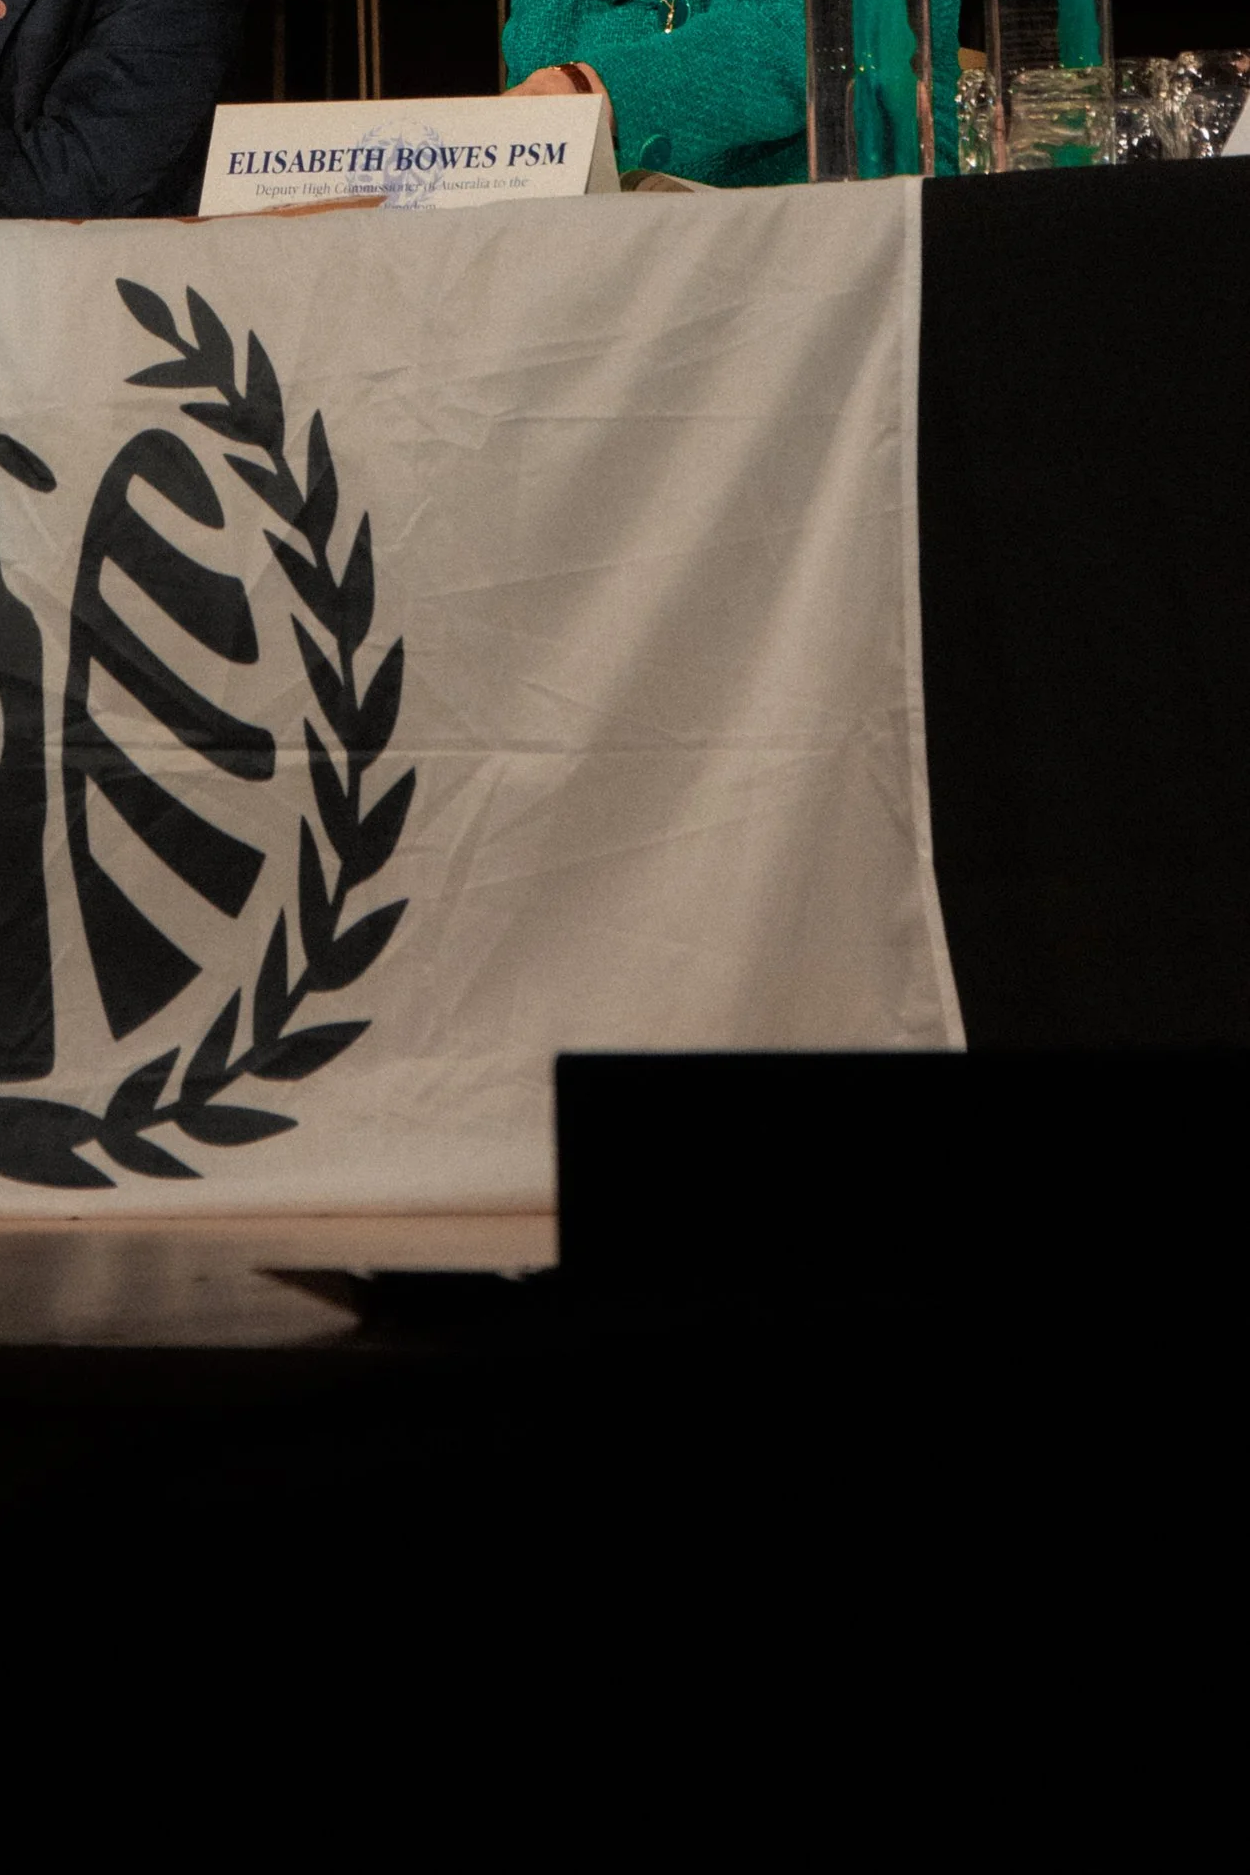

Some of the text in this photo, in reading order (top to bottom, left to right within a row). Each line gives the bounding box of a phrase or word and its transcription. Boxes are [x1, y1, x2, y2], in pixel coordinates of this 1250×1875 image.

[226, 141, 568, 175] ELISABETH BOWES PSM
[256, 183, 299, 198] Deputy
[302, 182, 331, 197] High
[441, 177, 491, 191] Australia
[494, 178, 506, 189] to
[509, 176, 529, 188] the
